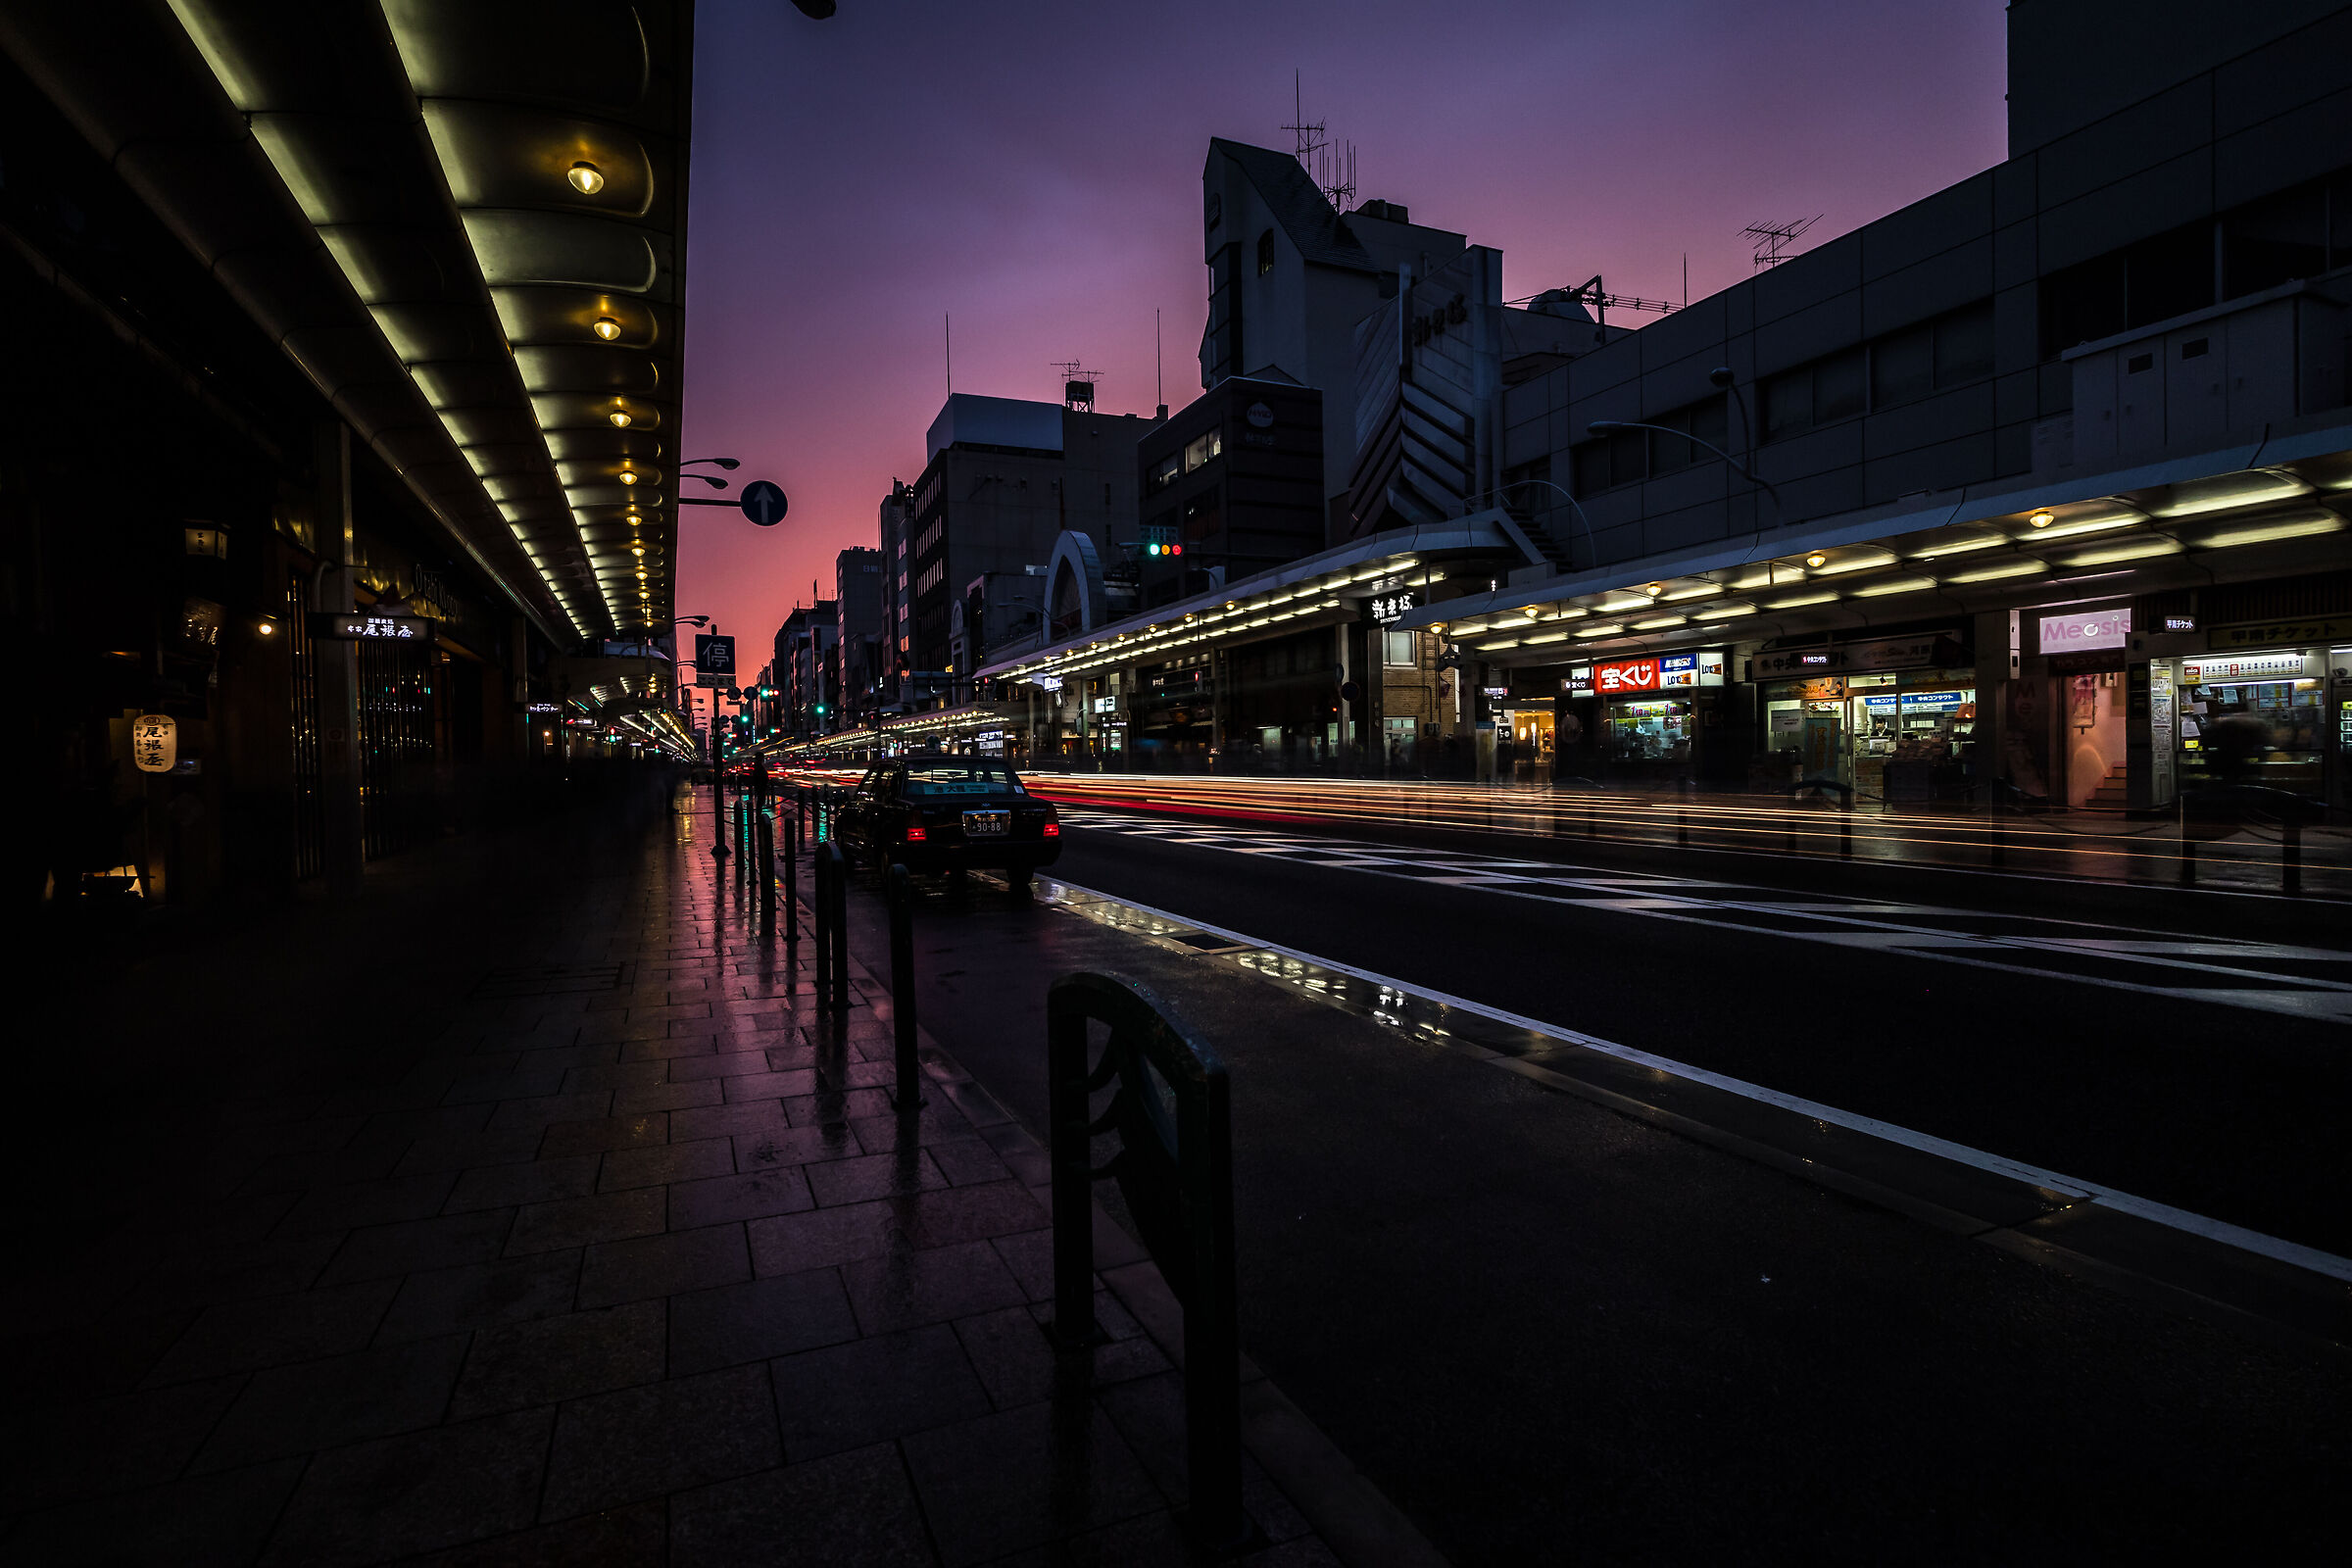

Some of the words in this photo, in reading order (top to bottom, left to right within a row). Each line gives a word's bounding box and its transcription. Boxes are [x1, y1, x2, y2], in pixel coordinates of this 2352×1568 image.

[703, 642, 729, 667] 停
[1600, 665, 1652, 689] 宝くじ
[143, 726, 165, 766] 尾張屋
